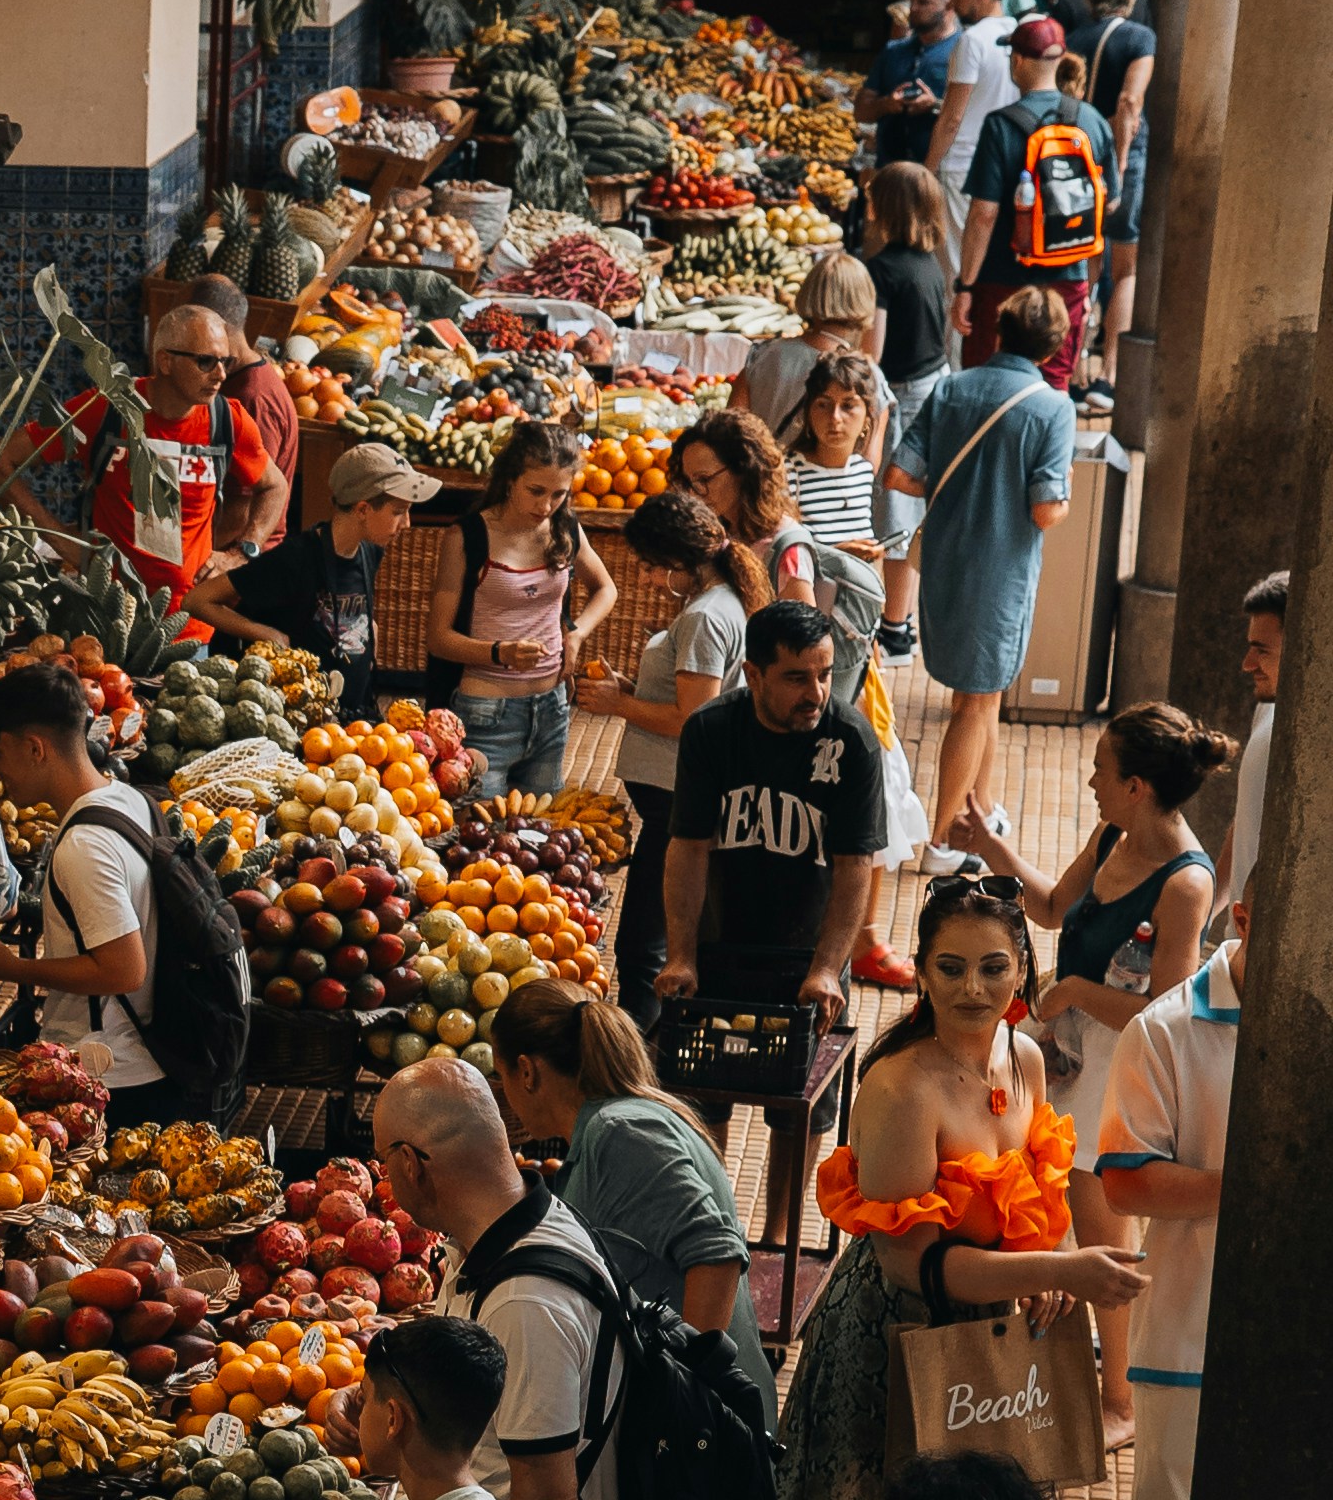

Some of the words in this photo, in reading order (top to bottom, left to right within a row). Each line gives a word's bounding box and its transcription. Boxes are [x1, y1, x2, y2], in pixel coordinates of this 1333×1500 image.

[718, 785, 827, 866] EADY
[947, 1364, 1049, 1430] Beach
[1025, 1413, 1053, 1433] Vibes
